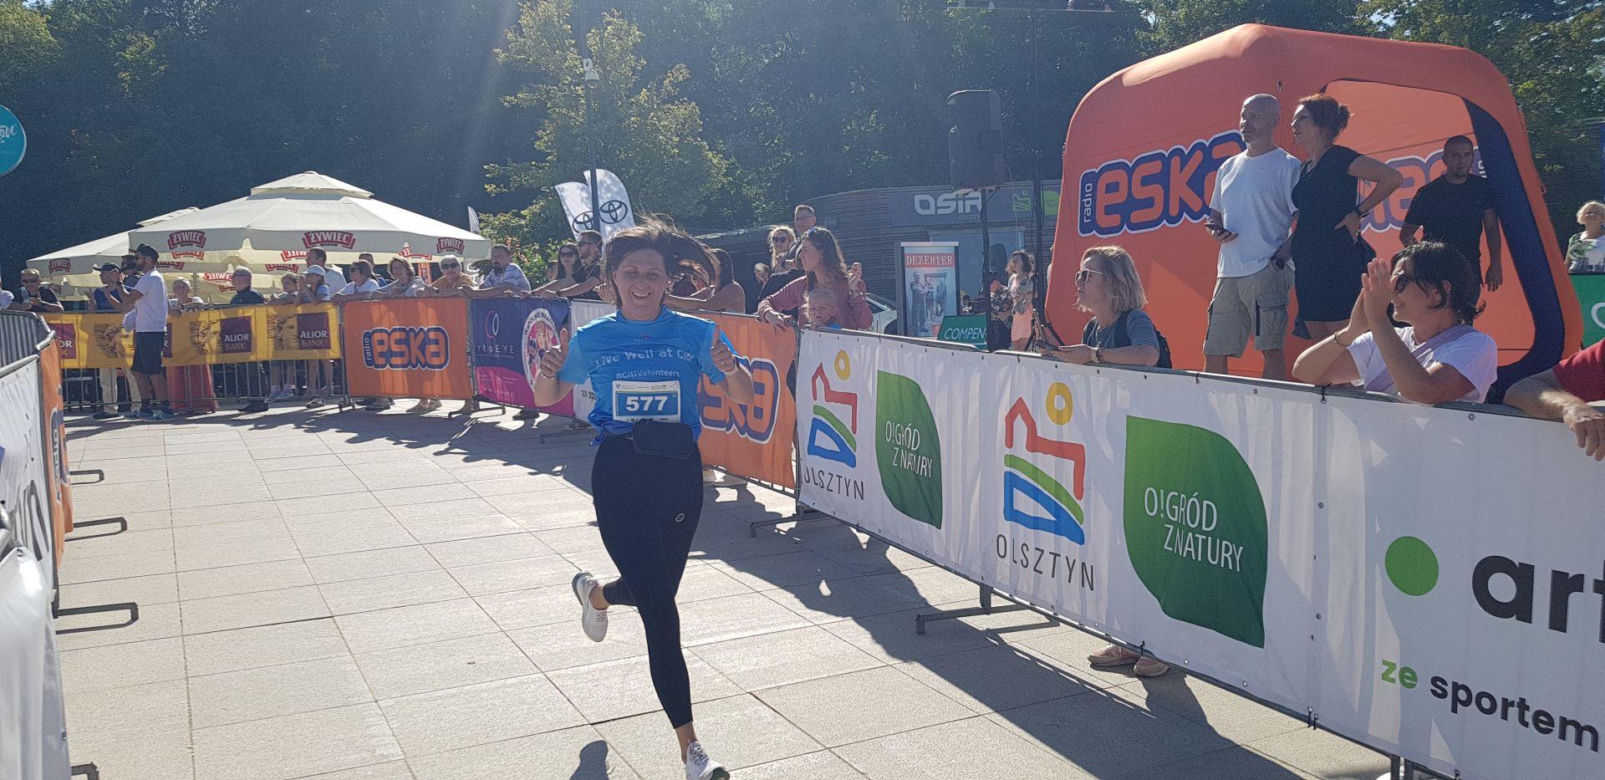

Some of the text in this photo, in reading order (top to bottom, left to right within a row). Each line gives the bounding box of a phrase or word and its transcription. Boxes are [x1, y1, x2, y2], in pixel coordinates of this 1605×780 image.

[1082, 183, 1093, 223] radio
[308, 231, 350, 244] ŻYWIEC
[224, 333, 249, 342] ALIOR
[300, 330, 328, 339] ALIOR
[624, 349, 653, 360] Well
[659, 347, 673, 358] at
[626, 396, 667, 412] 577
[1144, 487, 1218, 532] O!GRÓD
[996, 534, 1095, 591] OLSZTYN
[1381, 659, 1600, 752] ze sportem
